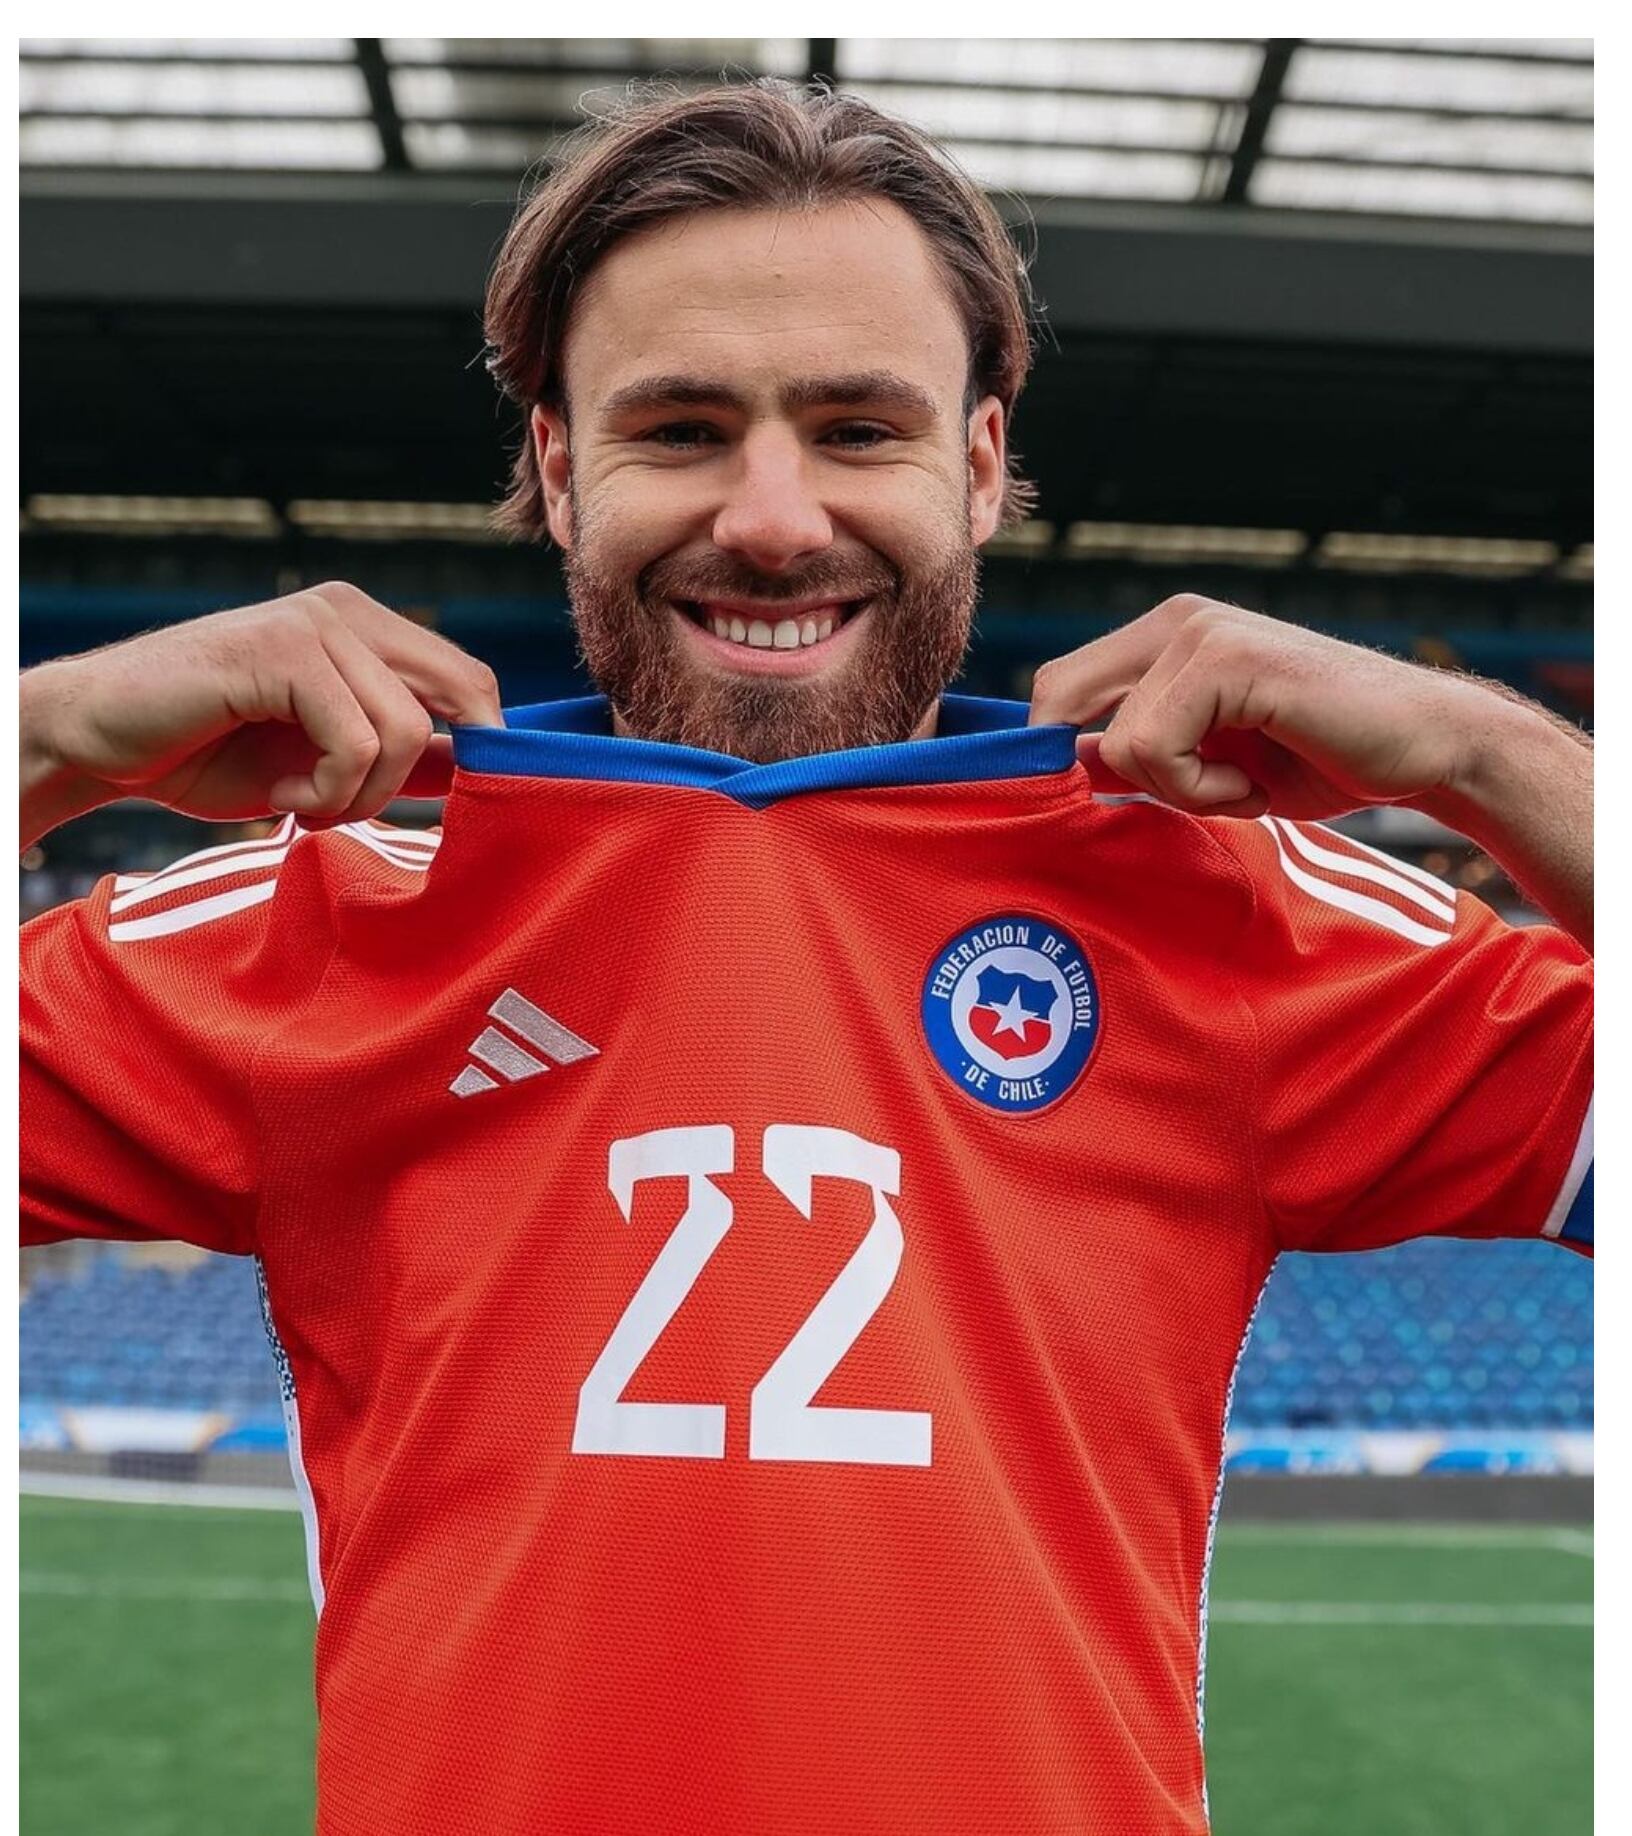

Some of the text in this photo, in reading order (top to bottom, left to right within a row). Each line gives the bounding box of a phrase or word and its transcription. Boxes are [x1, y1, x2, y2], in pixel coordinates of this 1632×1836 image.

[931, 924, 1093, 1032] FEDERACION DE FUTBOL
[964, 1064, 1046, 1102] DE CHILE
[571, 1123, 933, 1468] 22
